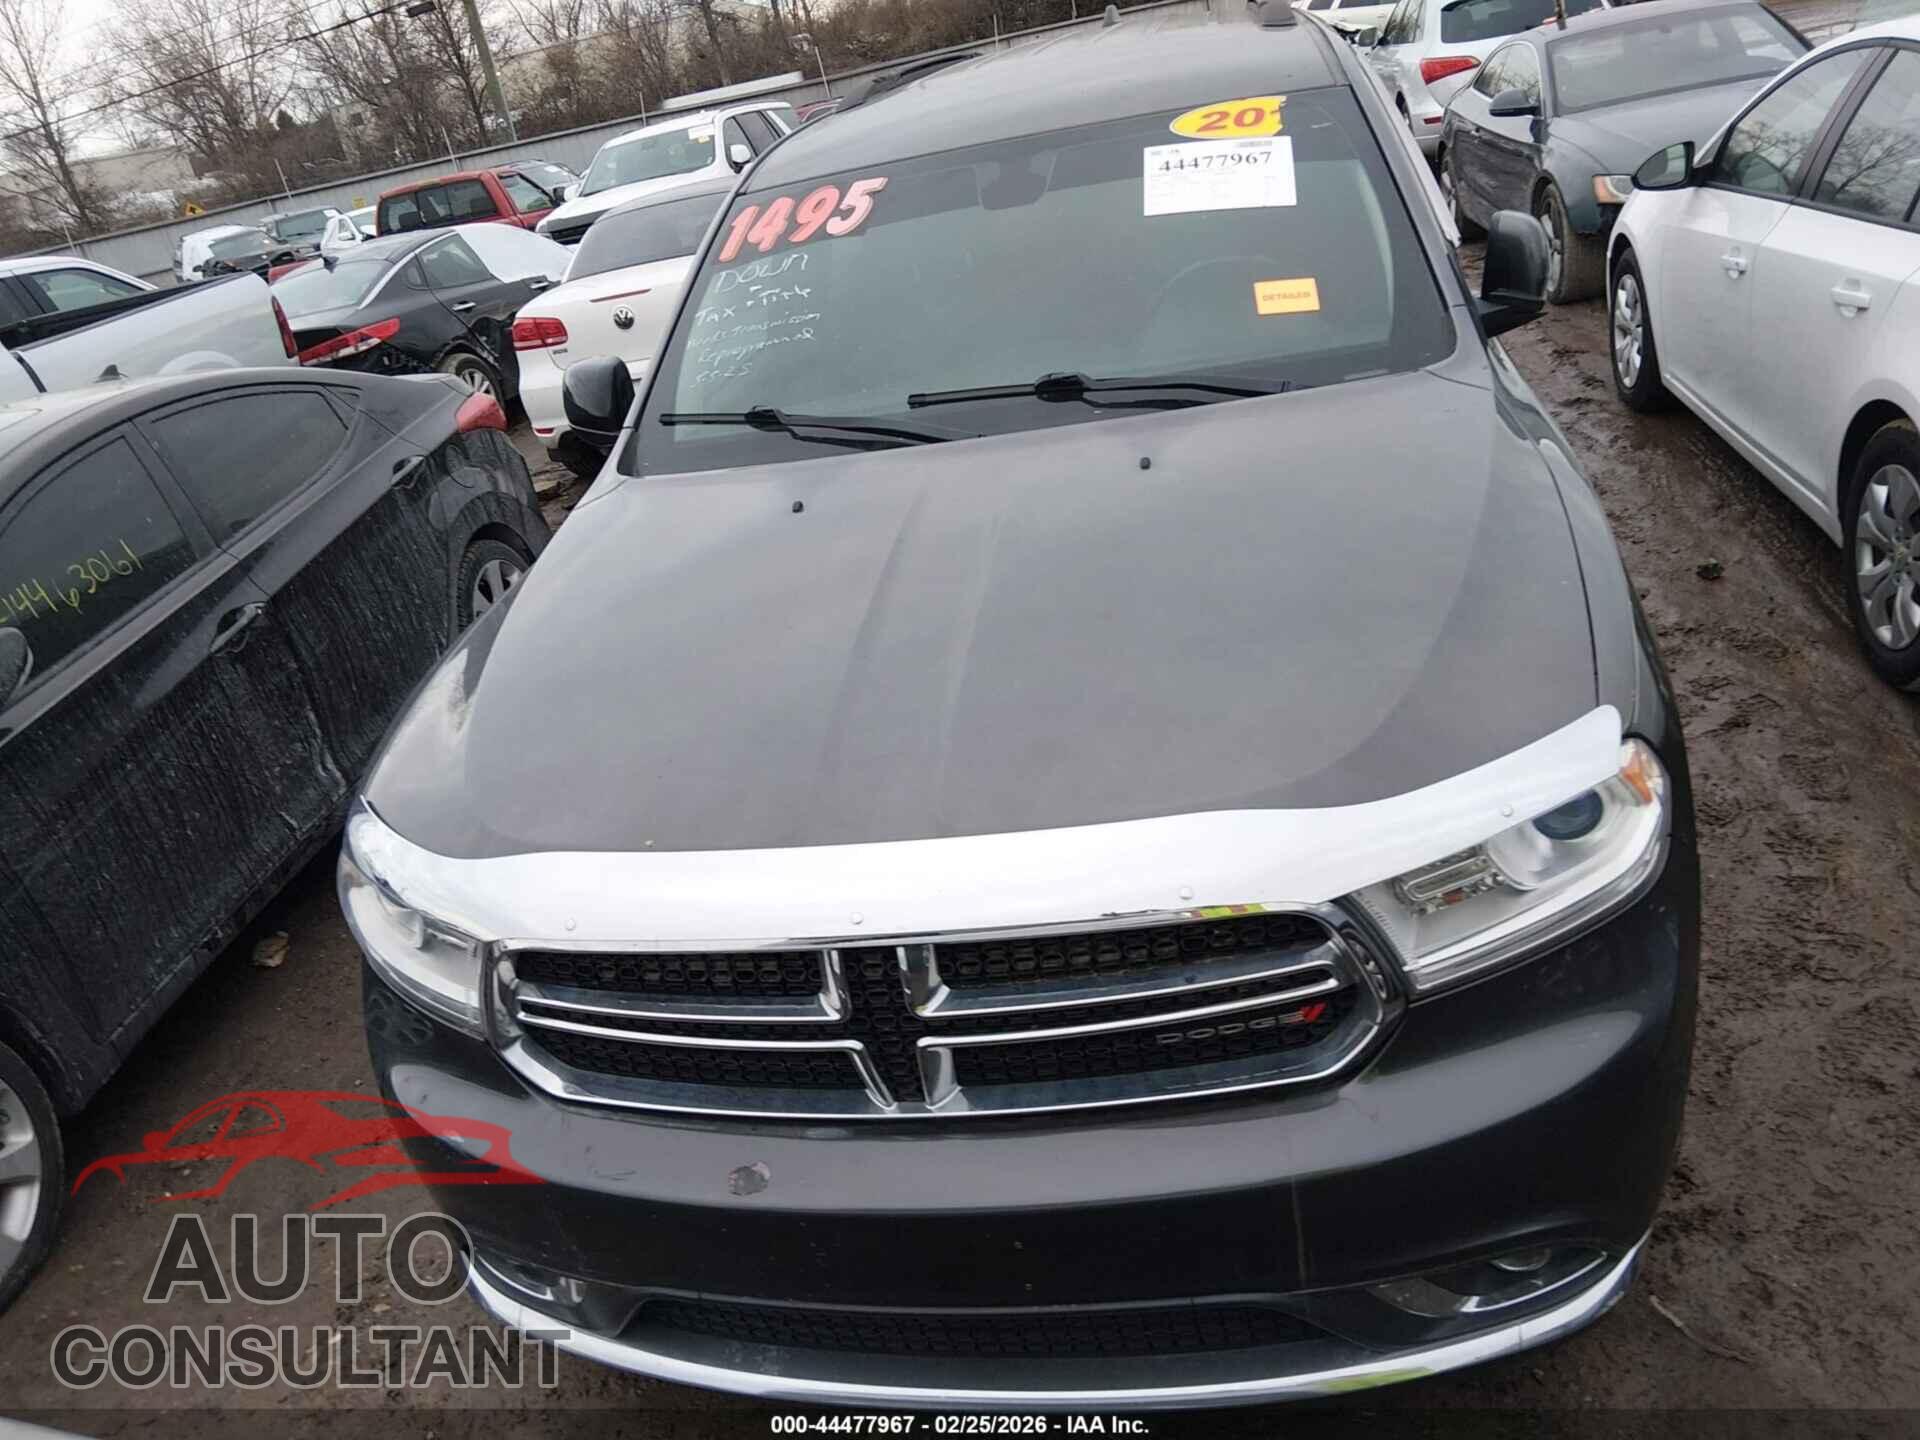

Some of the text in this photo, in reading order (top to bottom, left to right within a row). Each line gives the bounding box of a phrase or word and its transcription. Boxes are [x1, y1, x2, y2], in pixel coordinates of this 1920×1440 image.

[1195, 107, 1282, 133] 20
[1159, 151, 1272, 172] 44477967
[718, 177, 889, 263] 1495
[1155, 1010, 1305, 1045] DODGE
